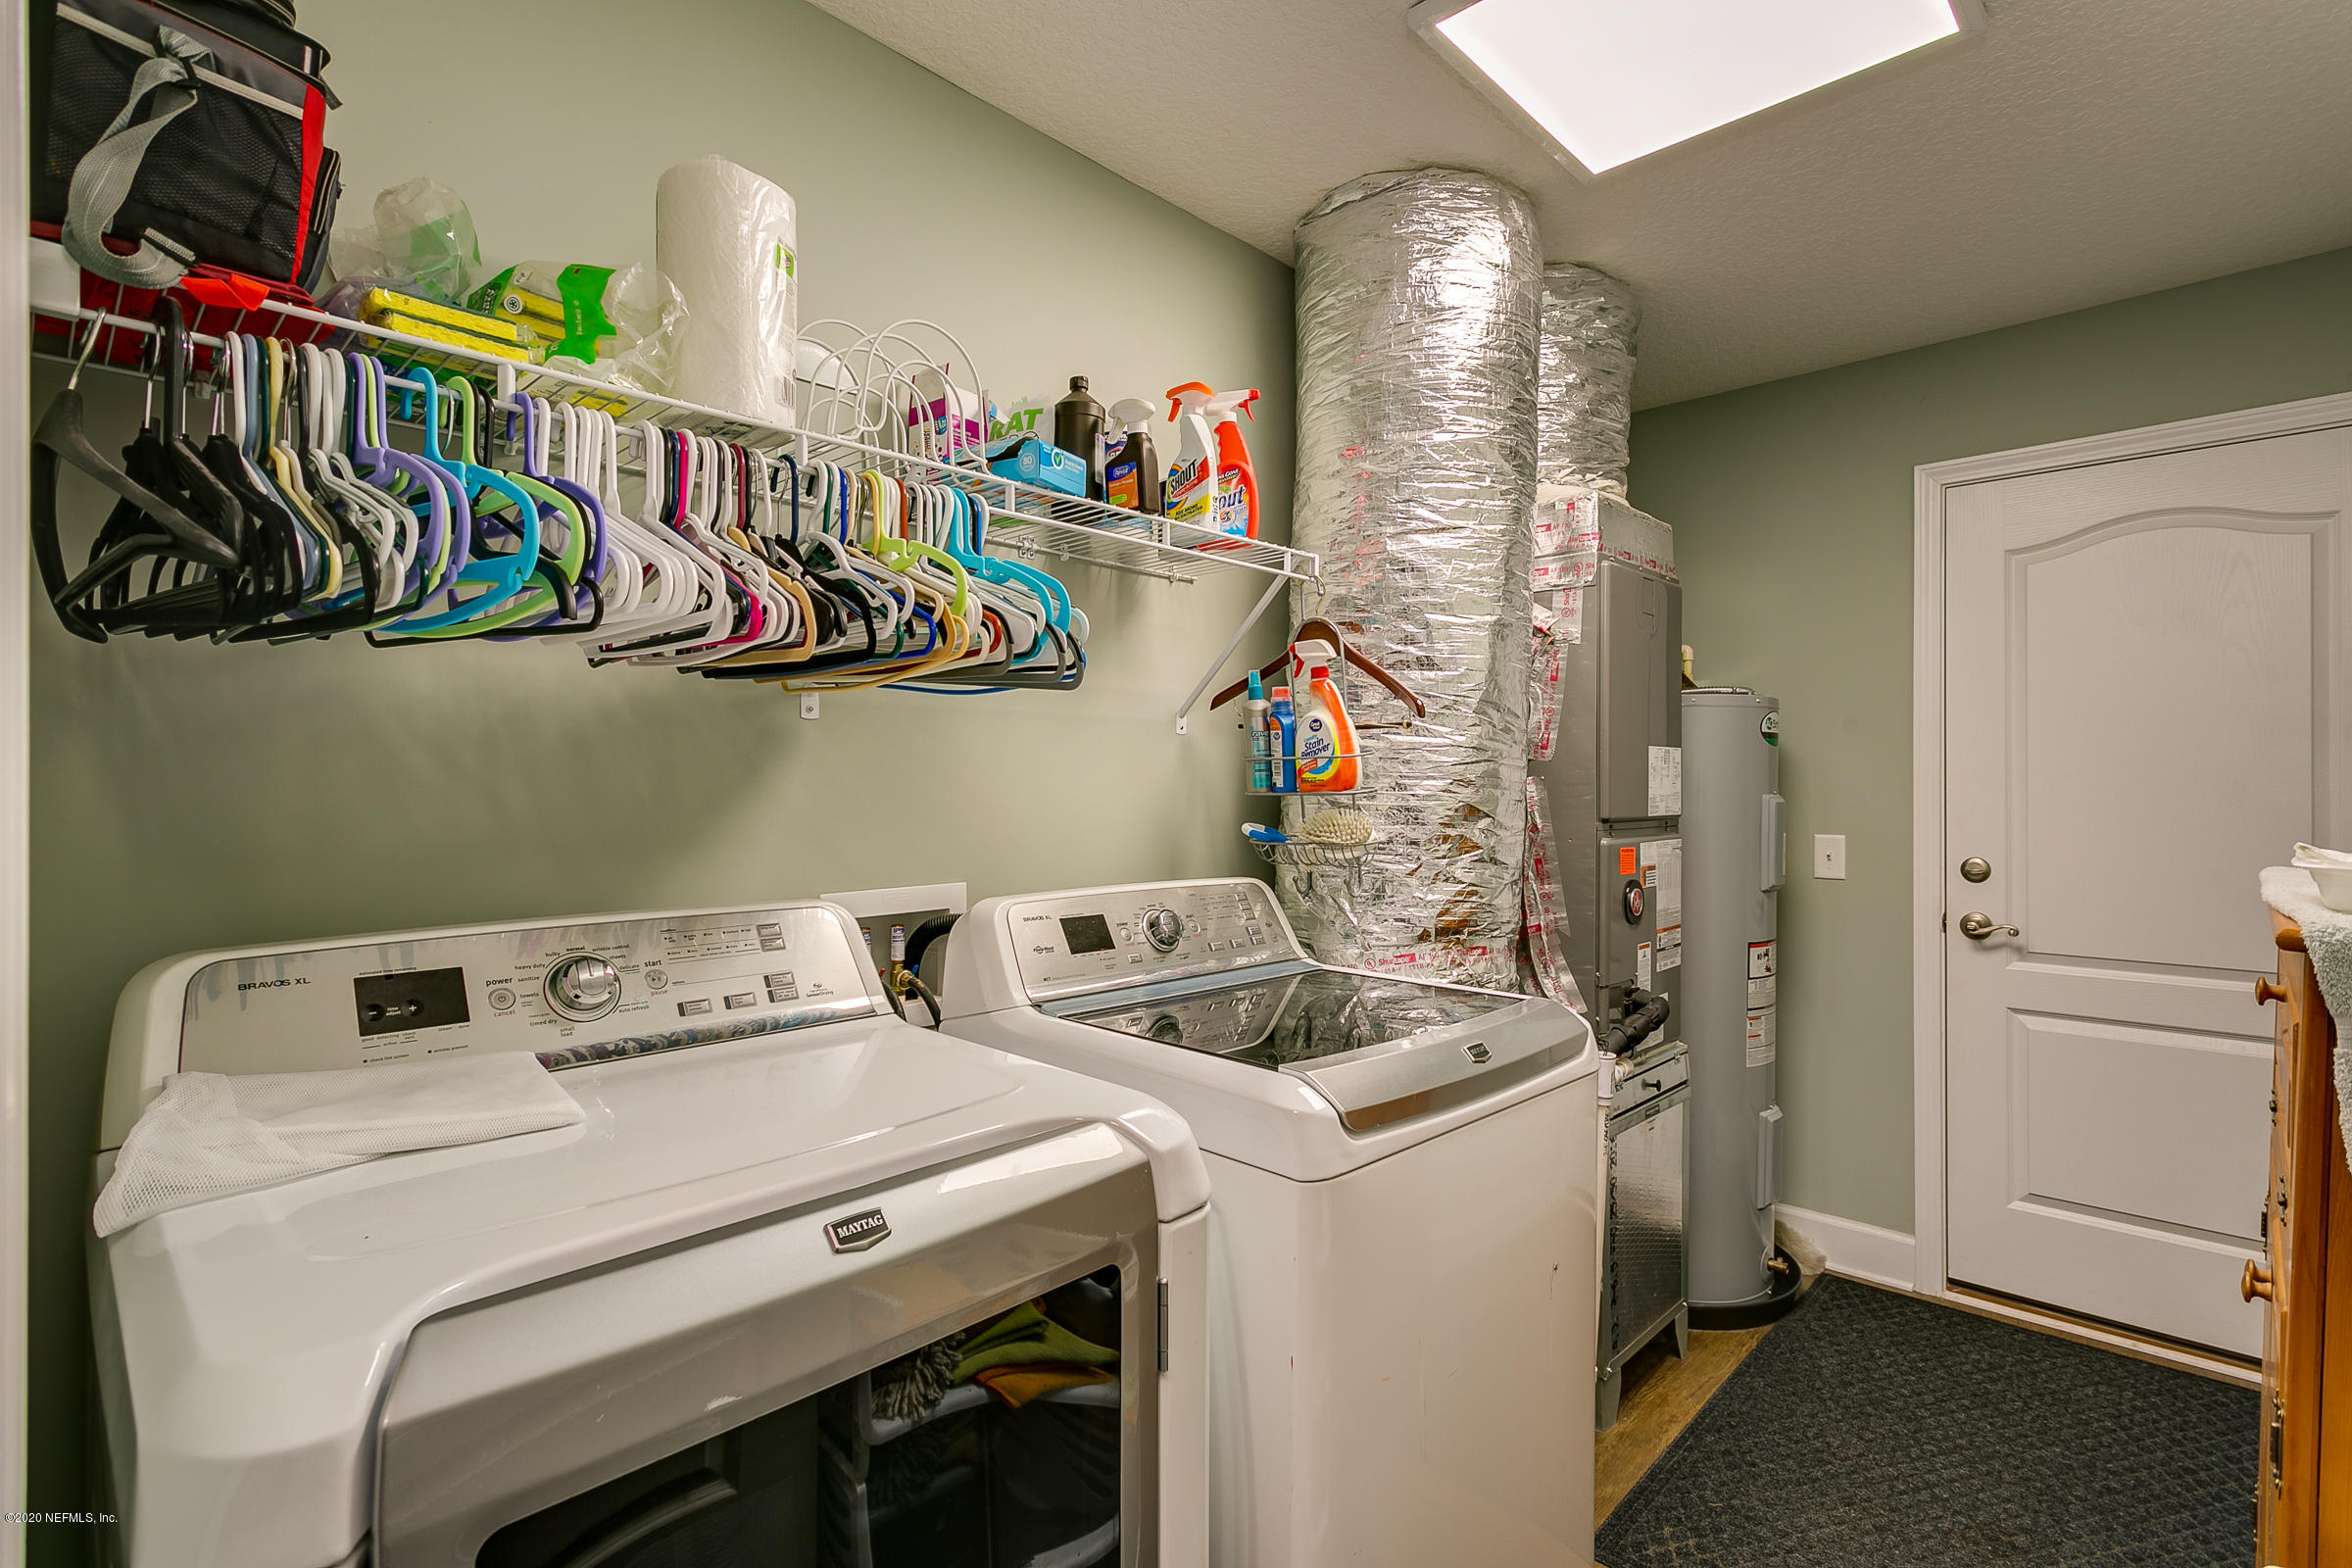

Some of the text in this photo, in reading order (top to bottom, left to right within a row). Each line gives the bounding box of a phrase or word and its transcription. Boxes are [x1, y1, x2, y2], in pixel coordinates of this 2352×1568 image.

[989, 408, 1043, 442] RAT
[1170, 459, 1198, 494] SHOUT
[1219, 486, 1246, 510] out
[1301, 743, 1331, 758] Remover
[1304, 738, 1324, 752] Stain
[644, 959, 662, 968] start
[237, 979, 291, 991] BRAVOS
[485, 977, 514, 987] power
[493, 1008, 515, 1017] cancel
[836, 1214, 884, 1239] MAYTAG
